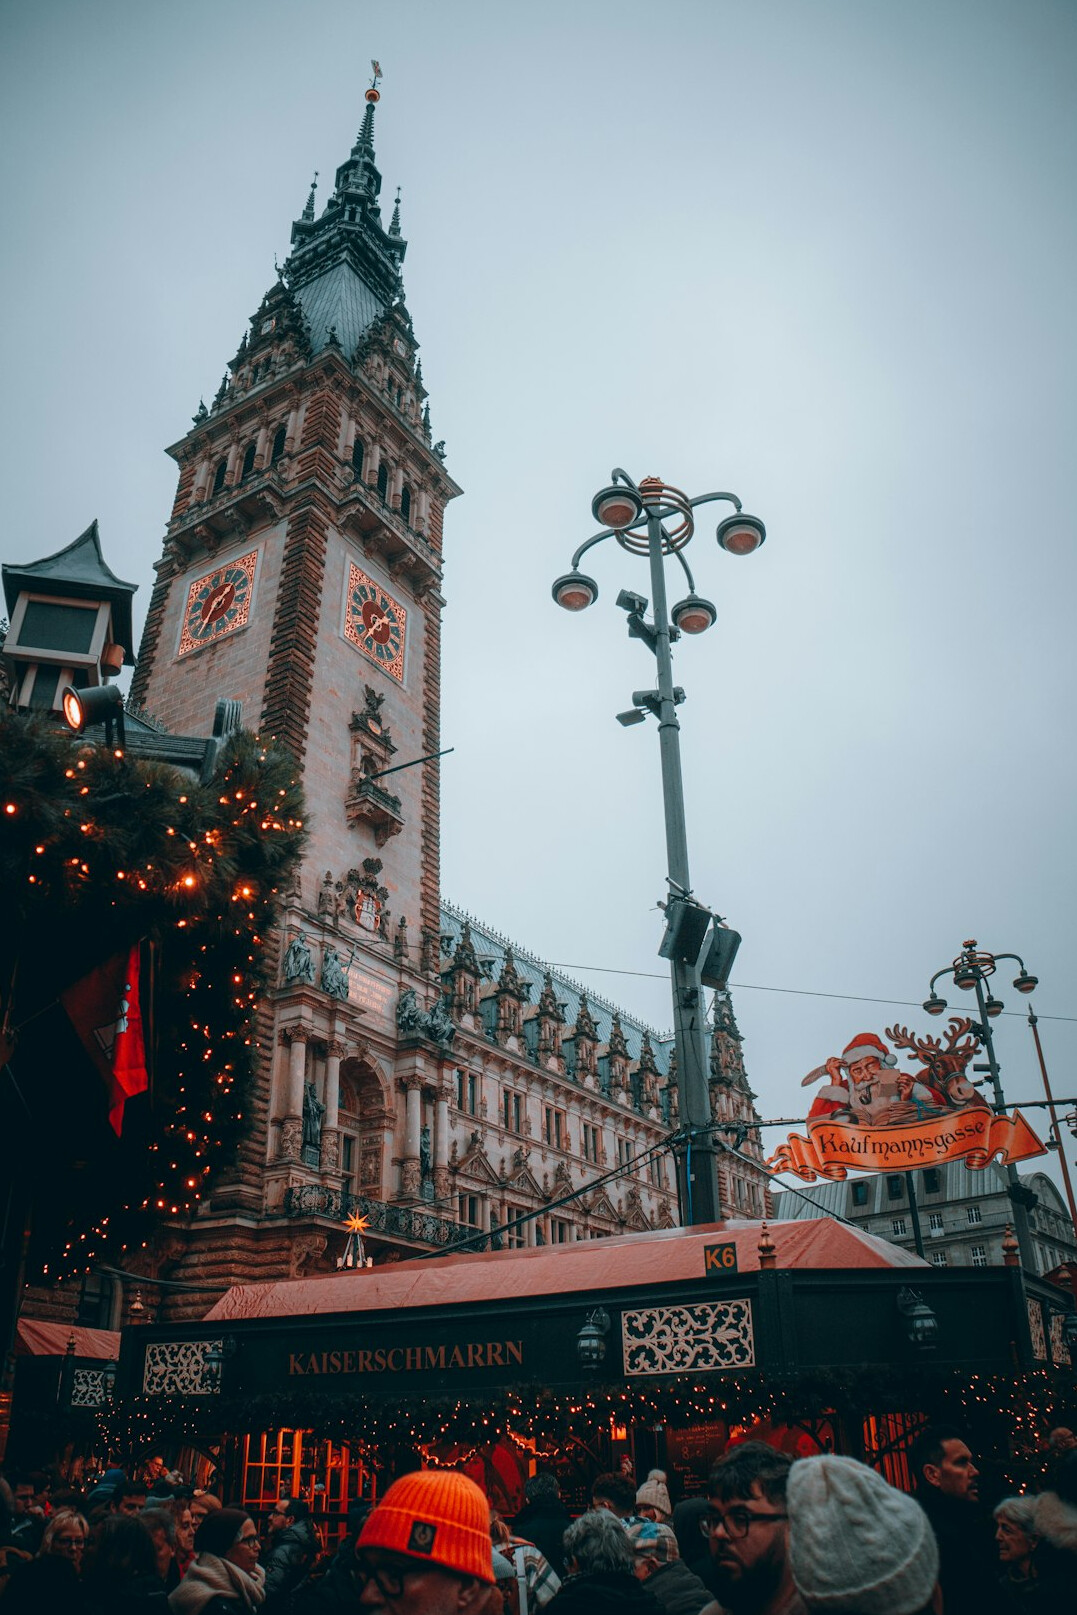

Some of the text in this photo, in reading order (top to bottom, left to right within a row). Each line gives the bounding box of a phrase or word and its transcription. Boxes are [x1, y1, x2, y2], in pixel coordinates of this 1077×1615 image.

[819, 1121, 985, 1160] Kaufmannsgasse
[705, 1247, 735, 1269] K6
[288, 1340, 523, 1375] KAISERSCHMARRN
